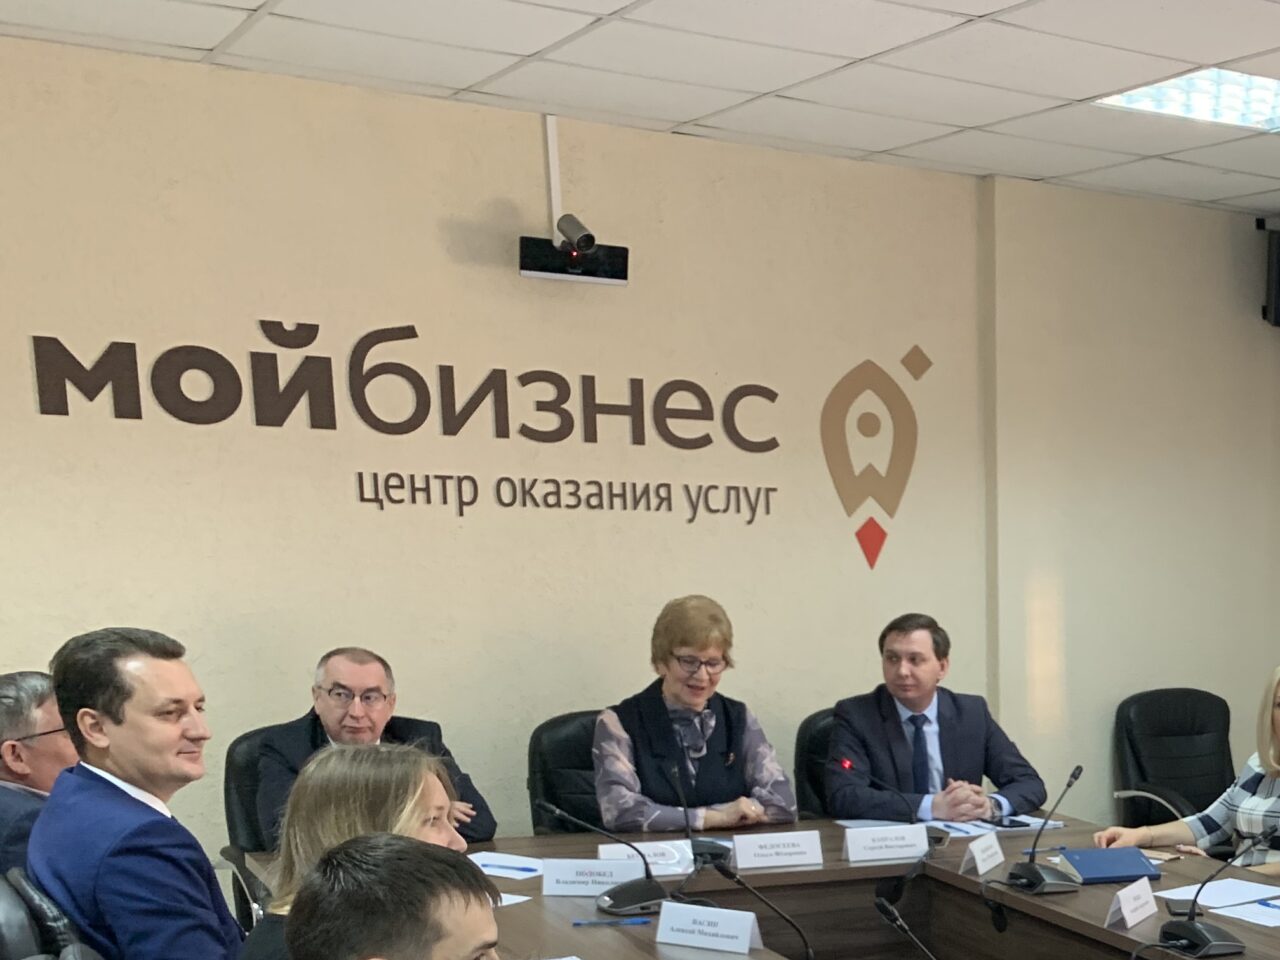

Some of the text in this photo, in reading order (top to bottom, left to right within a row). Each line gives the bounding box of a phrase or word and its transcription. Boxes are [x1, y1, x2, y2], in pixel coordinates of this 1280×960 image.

[357, 468, 778, 526] центр оказания услуг
